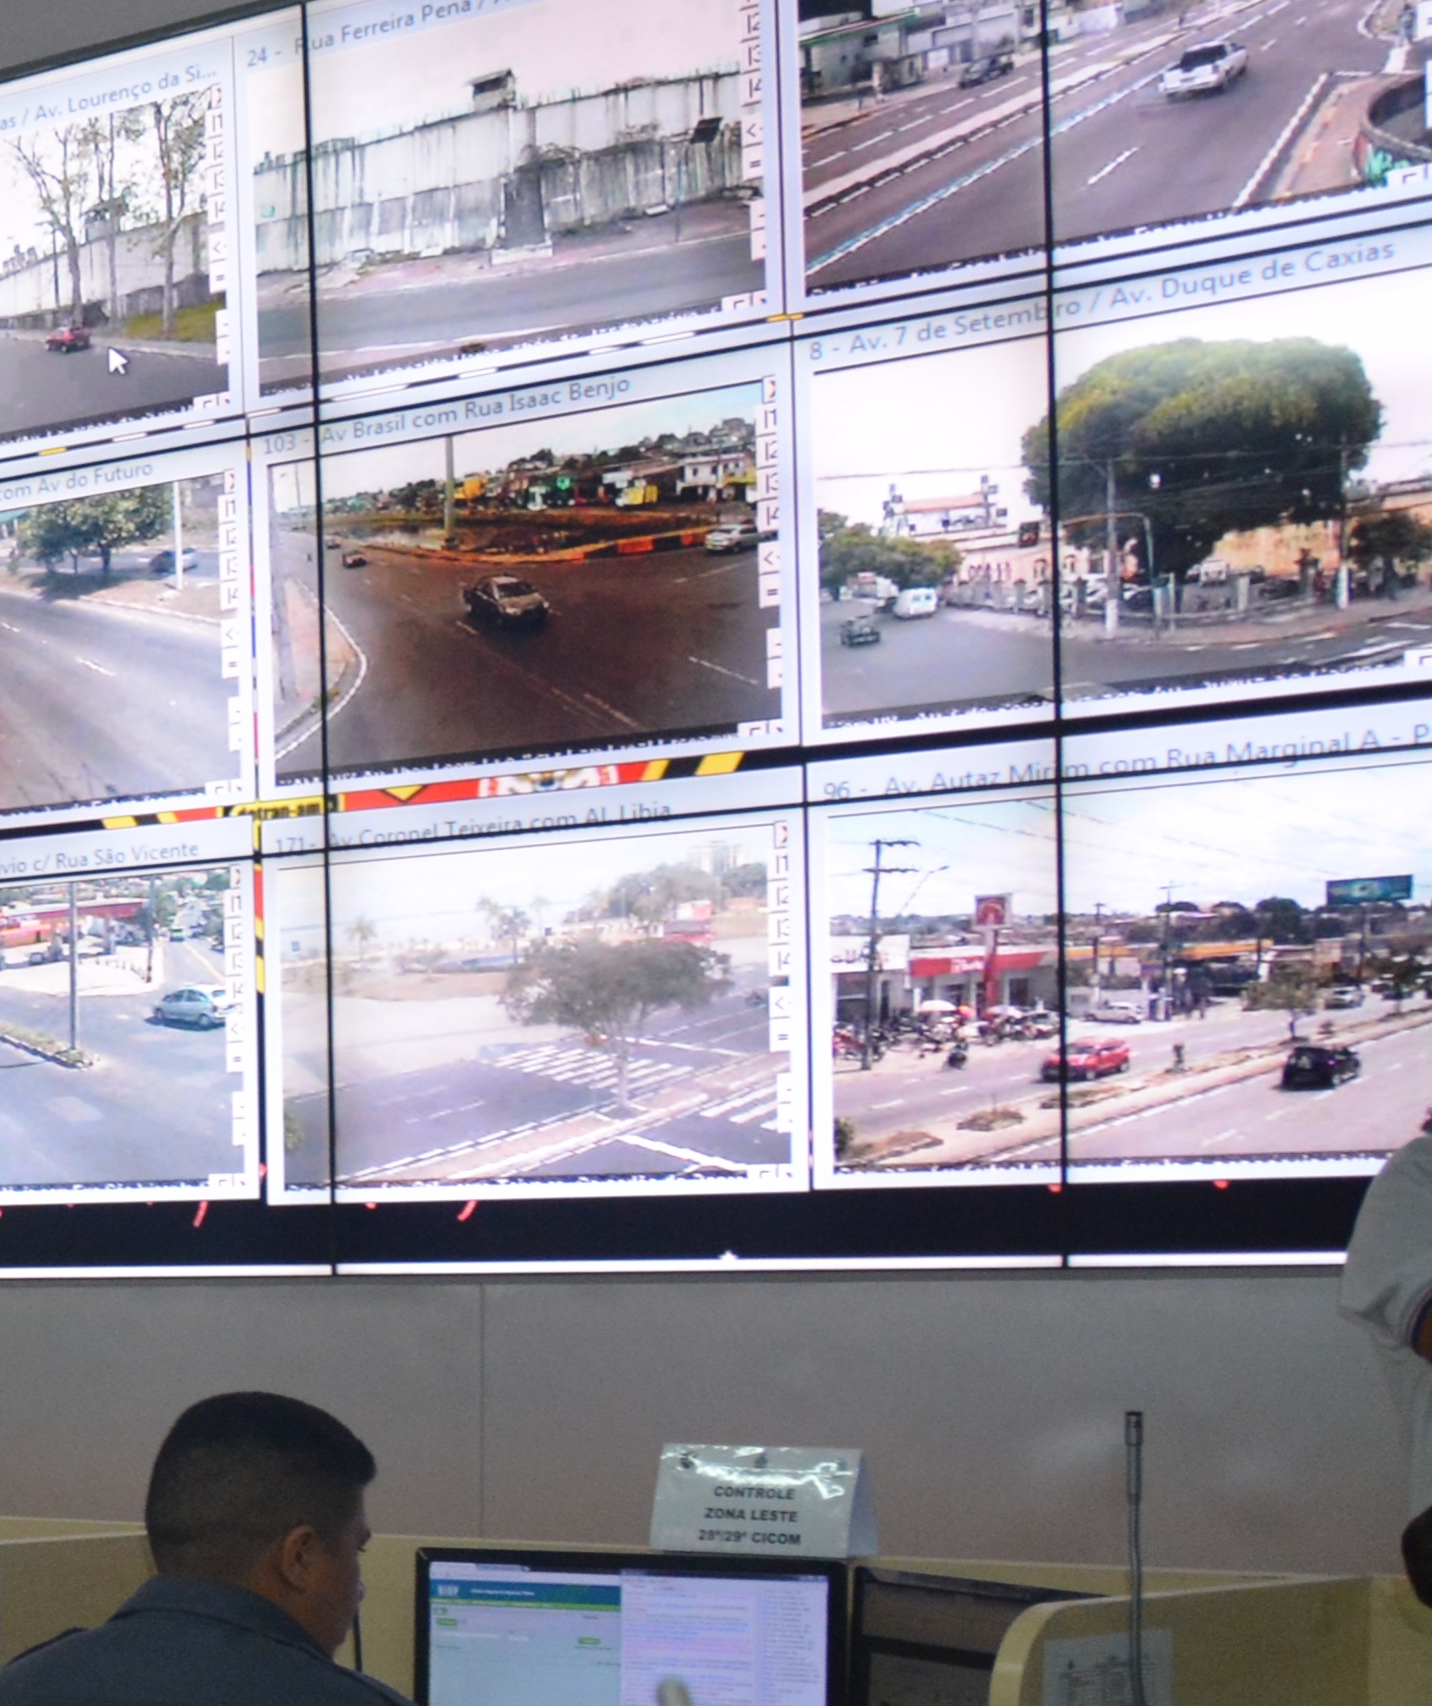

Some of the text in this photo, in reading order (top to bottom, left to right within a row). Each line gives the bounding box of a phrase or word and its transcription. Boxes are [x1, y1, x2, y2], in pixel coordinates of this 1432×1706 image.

[246, 15, 415, 68] 24 Rua Ferreira
[35, 103, 63, 121] Av.
[68, 79, 152, 115] Lourenço
[158, 73, 179, 90] da
[810, 239, 1395, 360] 8 Av. 7 de Setembro Av. Duque de Caxias
[263, 435, 295, 455] 103
[354, 414, 405, 439] Brasil
[413, 410, 458, 429] com
[464, 401, 502, 419] Rua
[508, 390, 561, 412] Isaac
[569, 378, 630, 402] Benjo
[66, 473, 88, 490] do
[94, 463, 153, 485] Futuro
[823, 781, 851, 801] 96
[931, 769, 1000, 792] Autaz
[1009, 760, 1090, 785] Mirm
[1098, 754, 1156, 775] com
[1167, 747, 1218, 769] Rua
[1226, 733, 1348, 770] Marginal
[1349, 730, 1379, 752] A
[359, 824, 438, 848] Coronel
[446, 817, 523, 839] Teixeira
[529, 811, 578, 831] com
[56, 852, 88, 869] Rua
[94, 847, 125, 865] São
[129, 842, 199, 862] Vicente
[714, 1486, 796, 1500] CONTROLE
[704, 1507, 798, 1522] ZONA LESTE
[752, 1532, 801, 1545] CICOM
